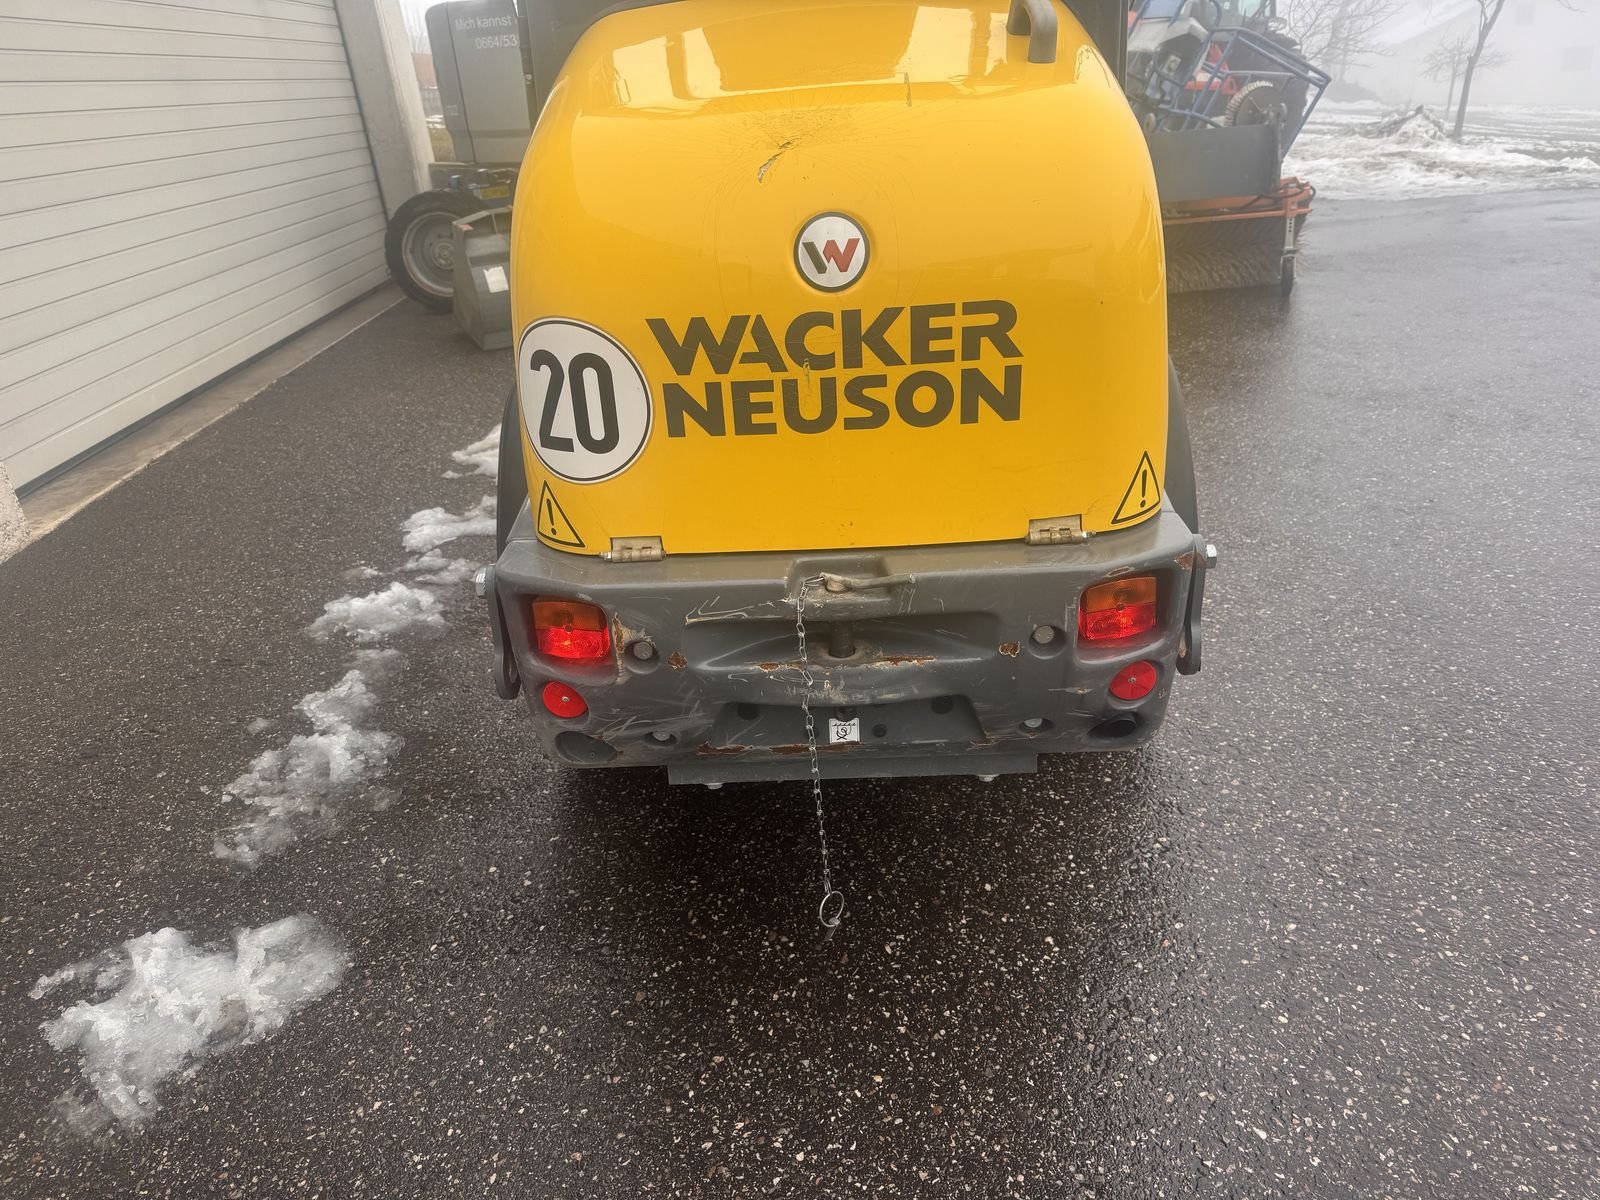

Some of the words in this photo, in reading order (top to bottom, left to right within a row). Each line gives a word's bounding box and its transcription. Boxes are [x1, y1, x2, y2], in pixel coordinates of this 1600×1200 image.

[476, 15, 512, 28] kannst
[645, 299, 1024, 376] WACKER
[529, 348, 619, 455] 20
[662, 364, 1023, 438] NEUSON
